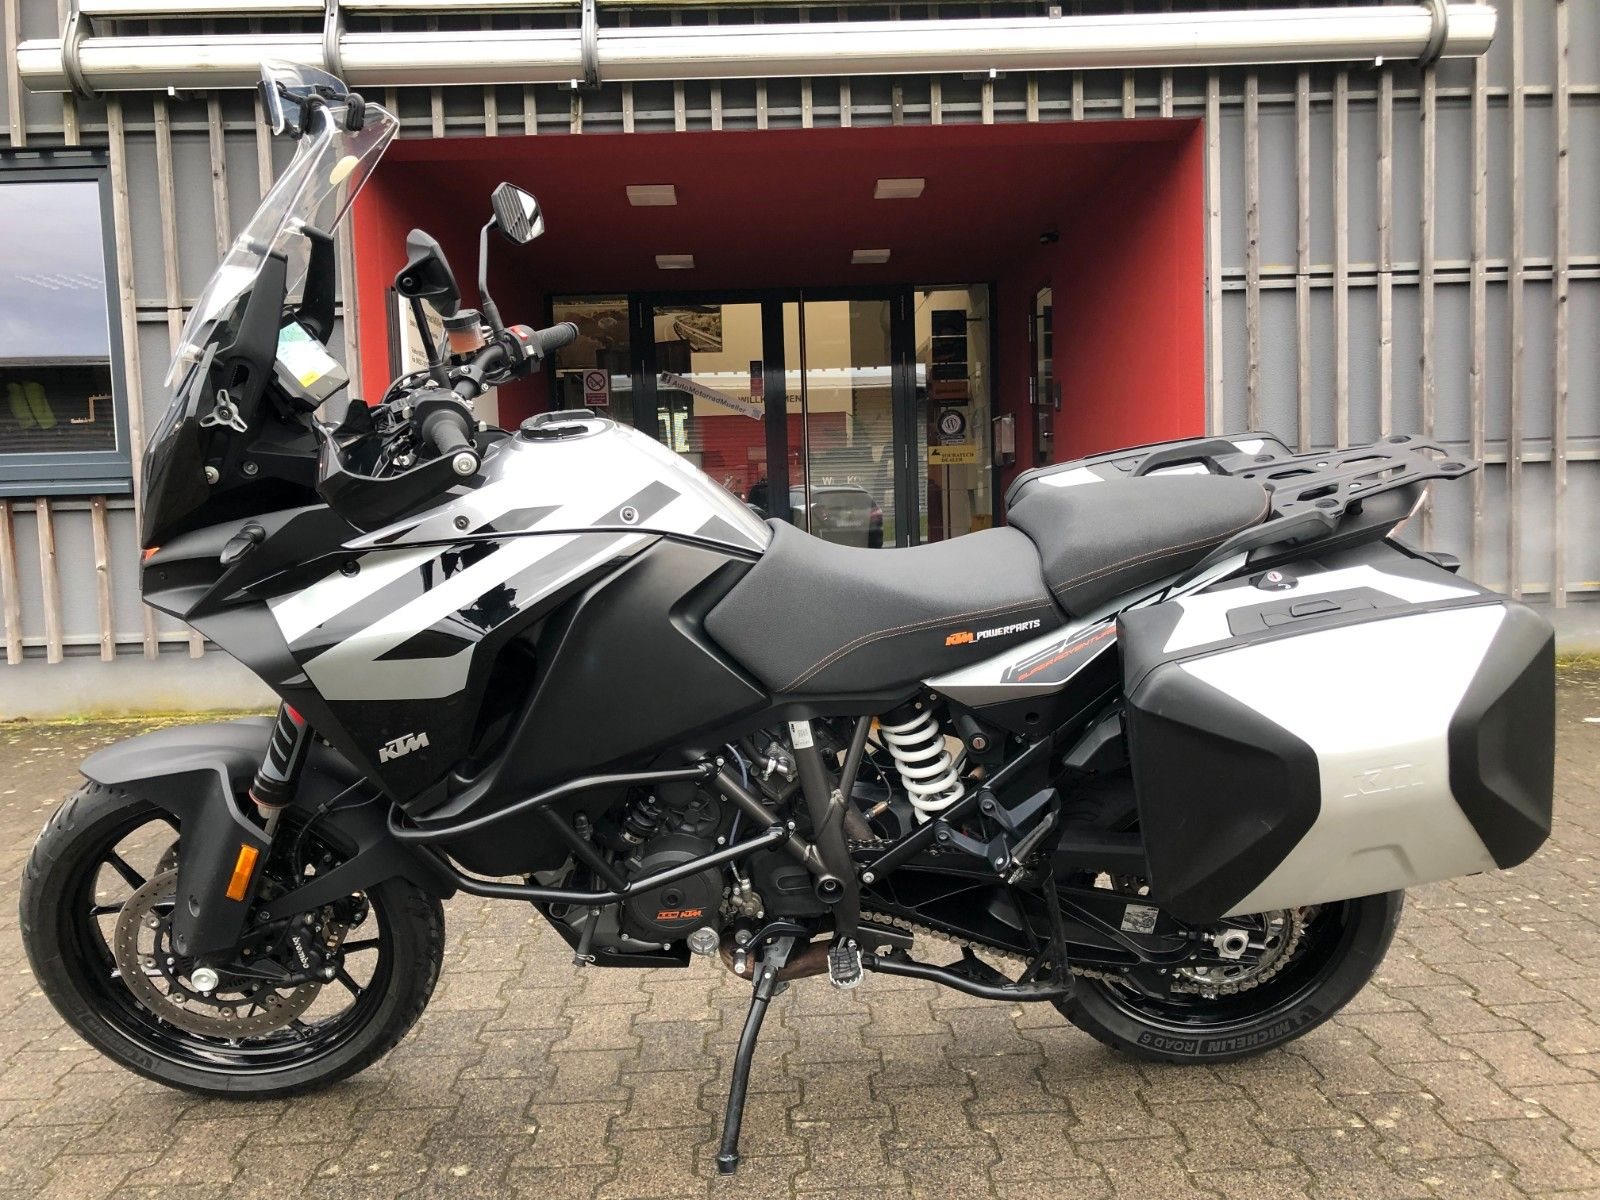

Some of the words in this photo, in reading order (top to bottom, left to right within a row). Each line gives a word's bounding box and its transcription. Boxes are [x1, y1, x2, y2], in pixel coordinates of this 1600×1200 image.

[672, 380, 746, 414] AutoMotorradMueller
[944, 630, 974, 647] KTM
[379, 732, 430, 764] KTM
[292, 936, 310, 969] brembo
[1142, 1033, 1151, 1044] 6
[1155, 1036, 1196, 1052] ROAD
[1207, 1020, 1291, 1053] MICHELIN
